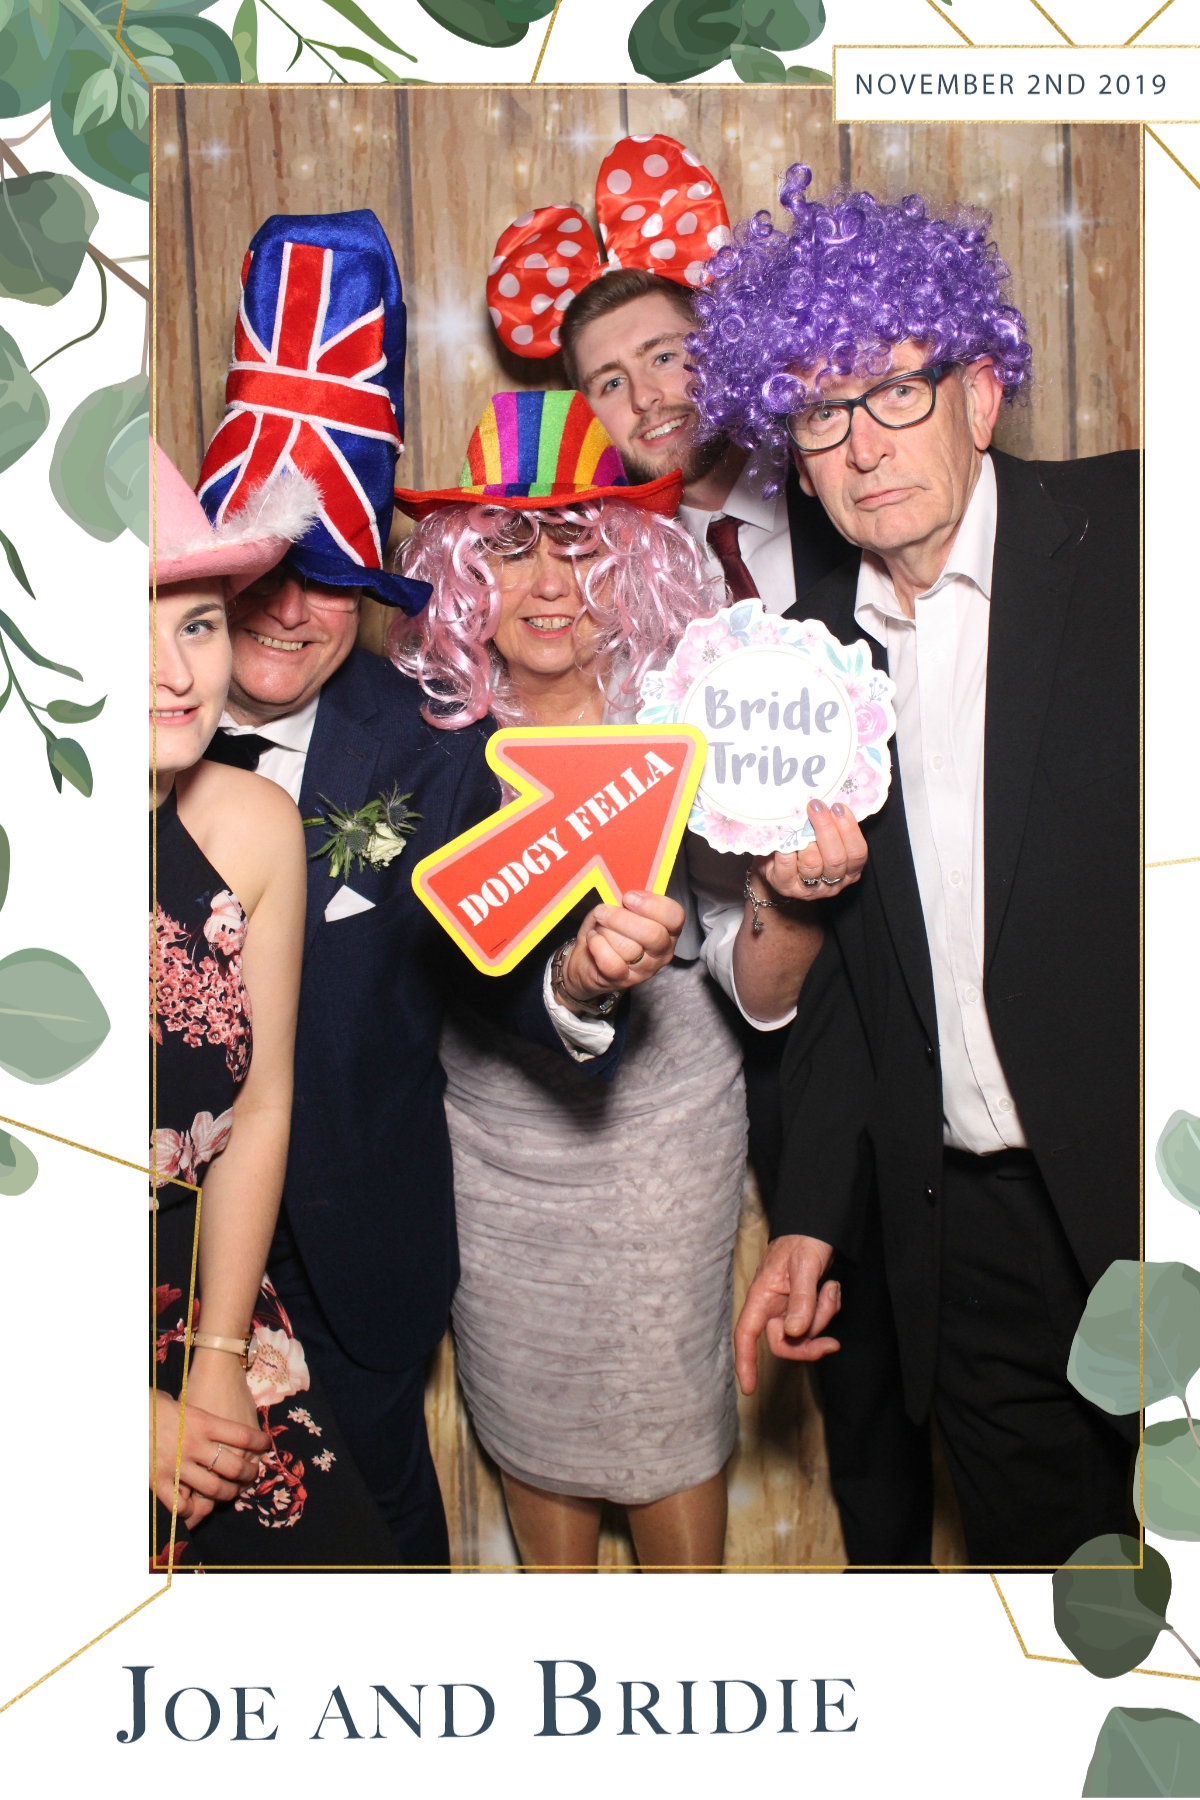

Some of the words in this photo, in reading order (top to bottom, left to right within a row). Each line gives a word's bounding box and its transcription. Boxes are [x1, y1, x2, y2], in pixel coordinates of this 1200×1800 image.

[704, 685, 840, 736] Bride
[707, 741, 827, 788] Tribe
[456, 826, 569, 927] DODGY
[564, 750, 675, 842] FELLA
